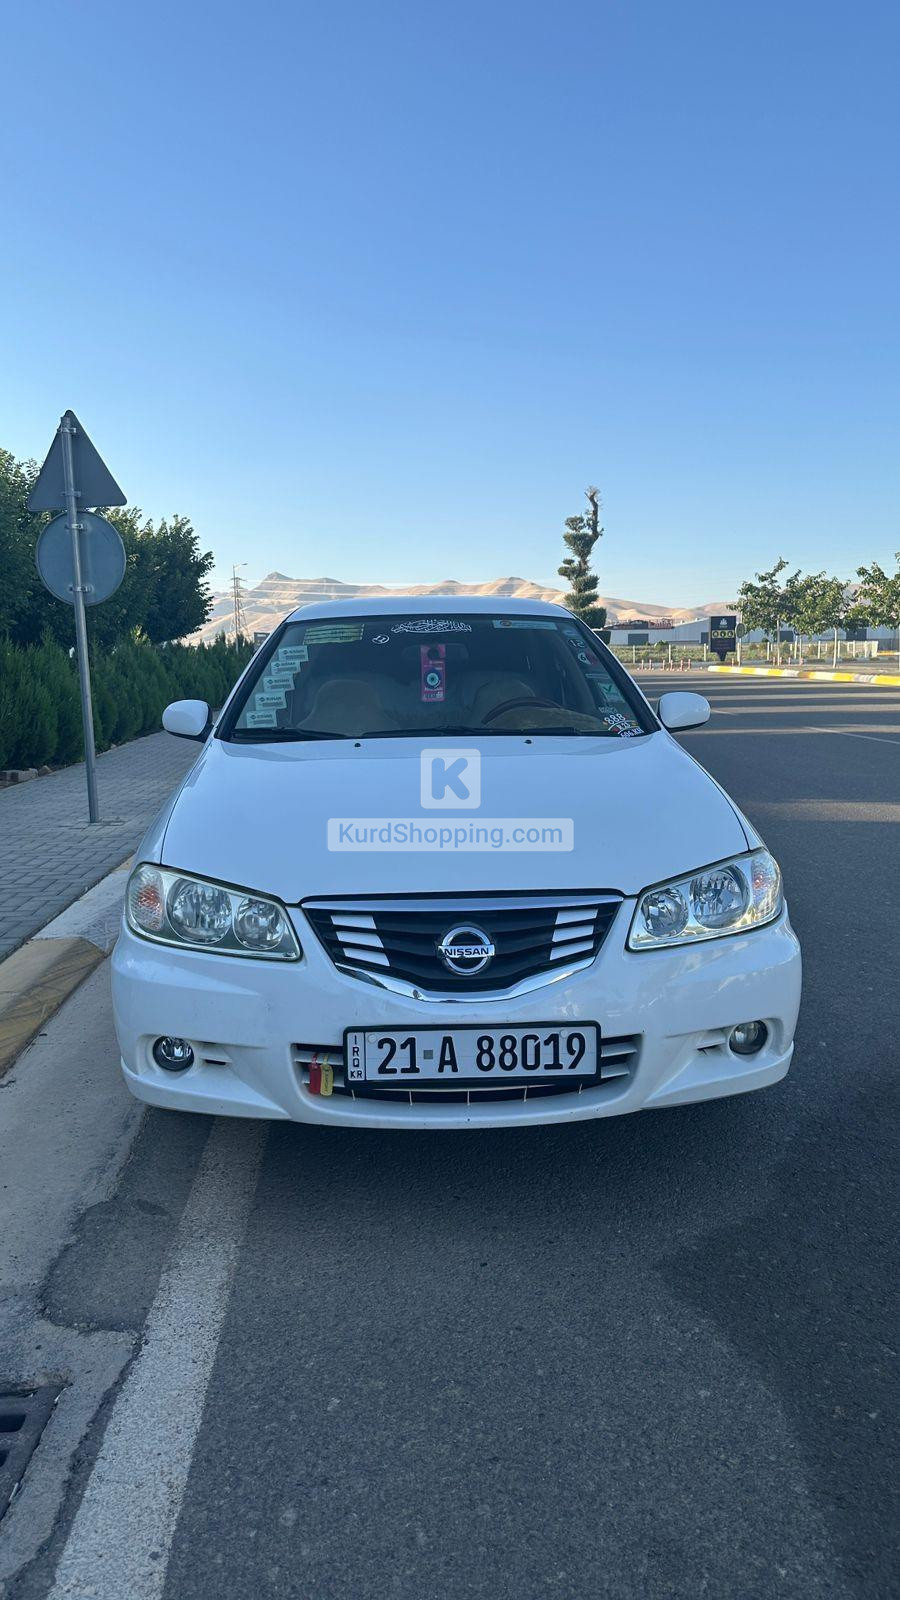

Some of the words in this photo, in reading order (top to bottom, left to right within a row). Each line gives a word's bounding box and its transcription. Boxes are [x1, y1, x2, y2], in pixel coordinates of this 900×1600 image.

[444, 947, 490, 956] NISSAN
[376, 1036, 421, 1075] 21
[437, 1036, 459, 1074] A
[475, 1032, 587, 1072] 88019
[350, 1070, 363, 1079] KR
